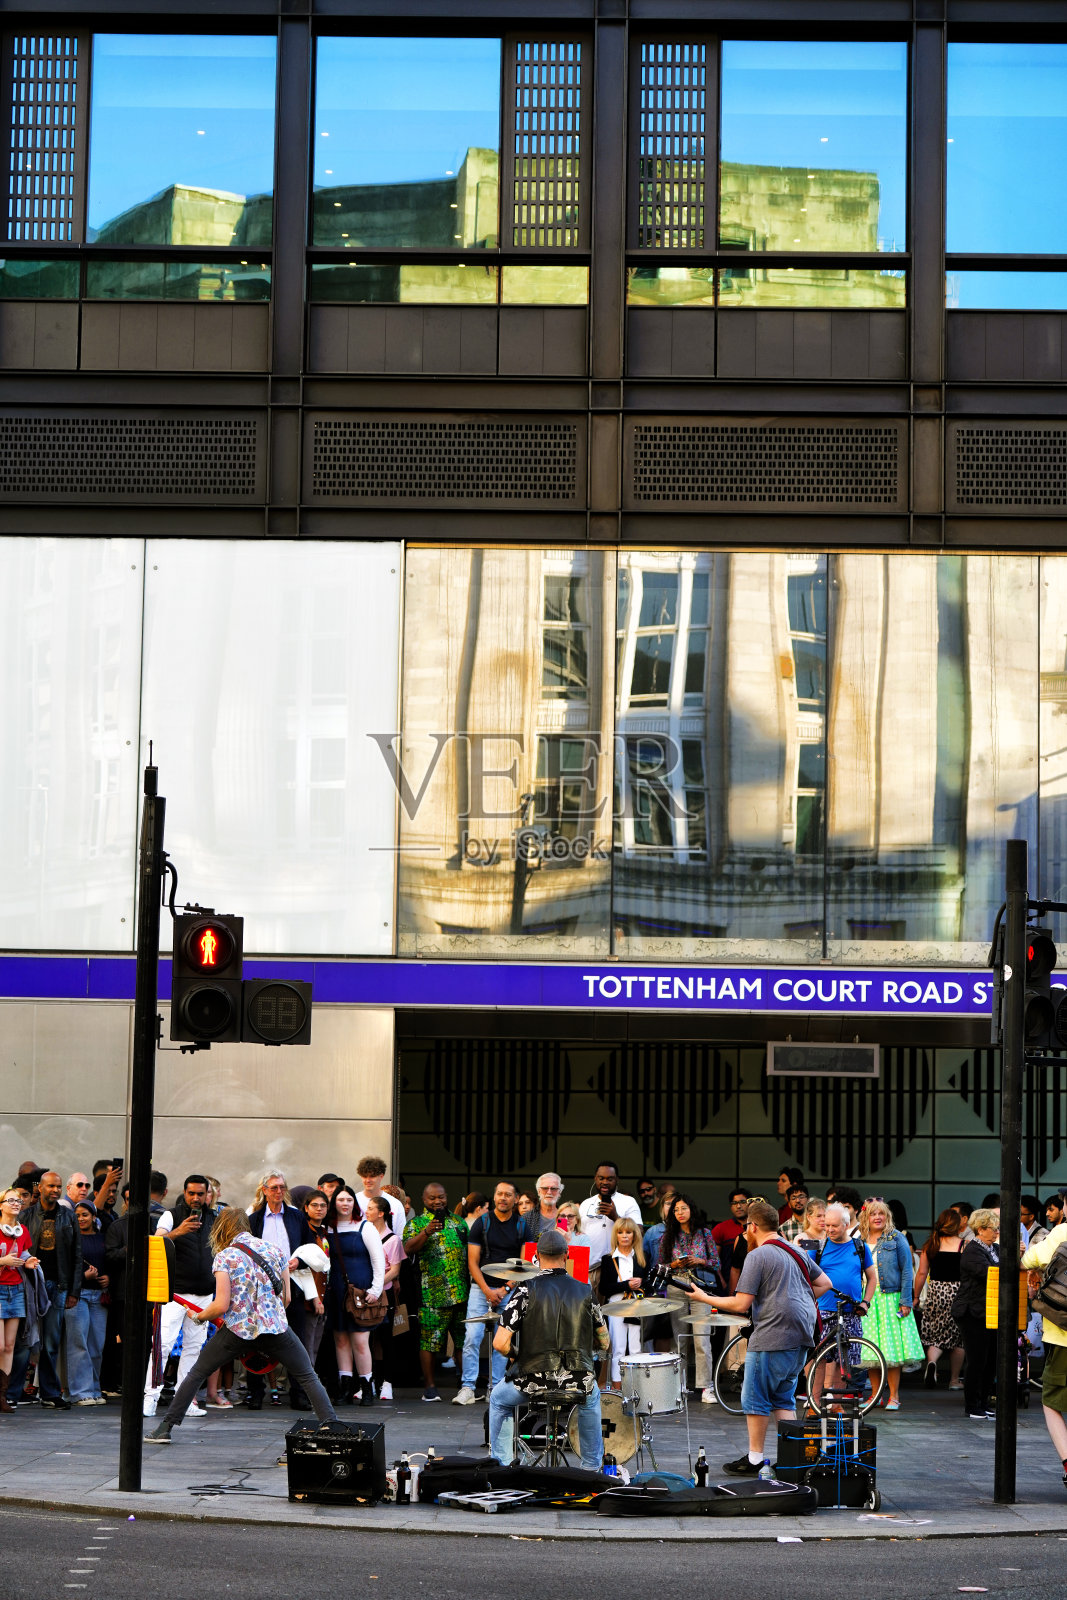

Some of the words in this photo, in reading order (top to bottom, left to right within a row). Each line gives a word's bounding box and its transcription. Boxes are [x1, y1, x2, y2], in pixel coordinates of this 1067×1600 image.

[583, 976, 762, 999] TOTTENHAM
[773, 979, 873, 1002] COURT
[884, 981, 963, 1004] ROAD
